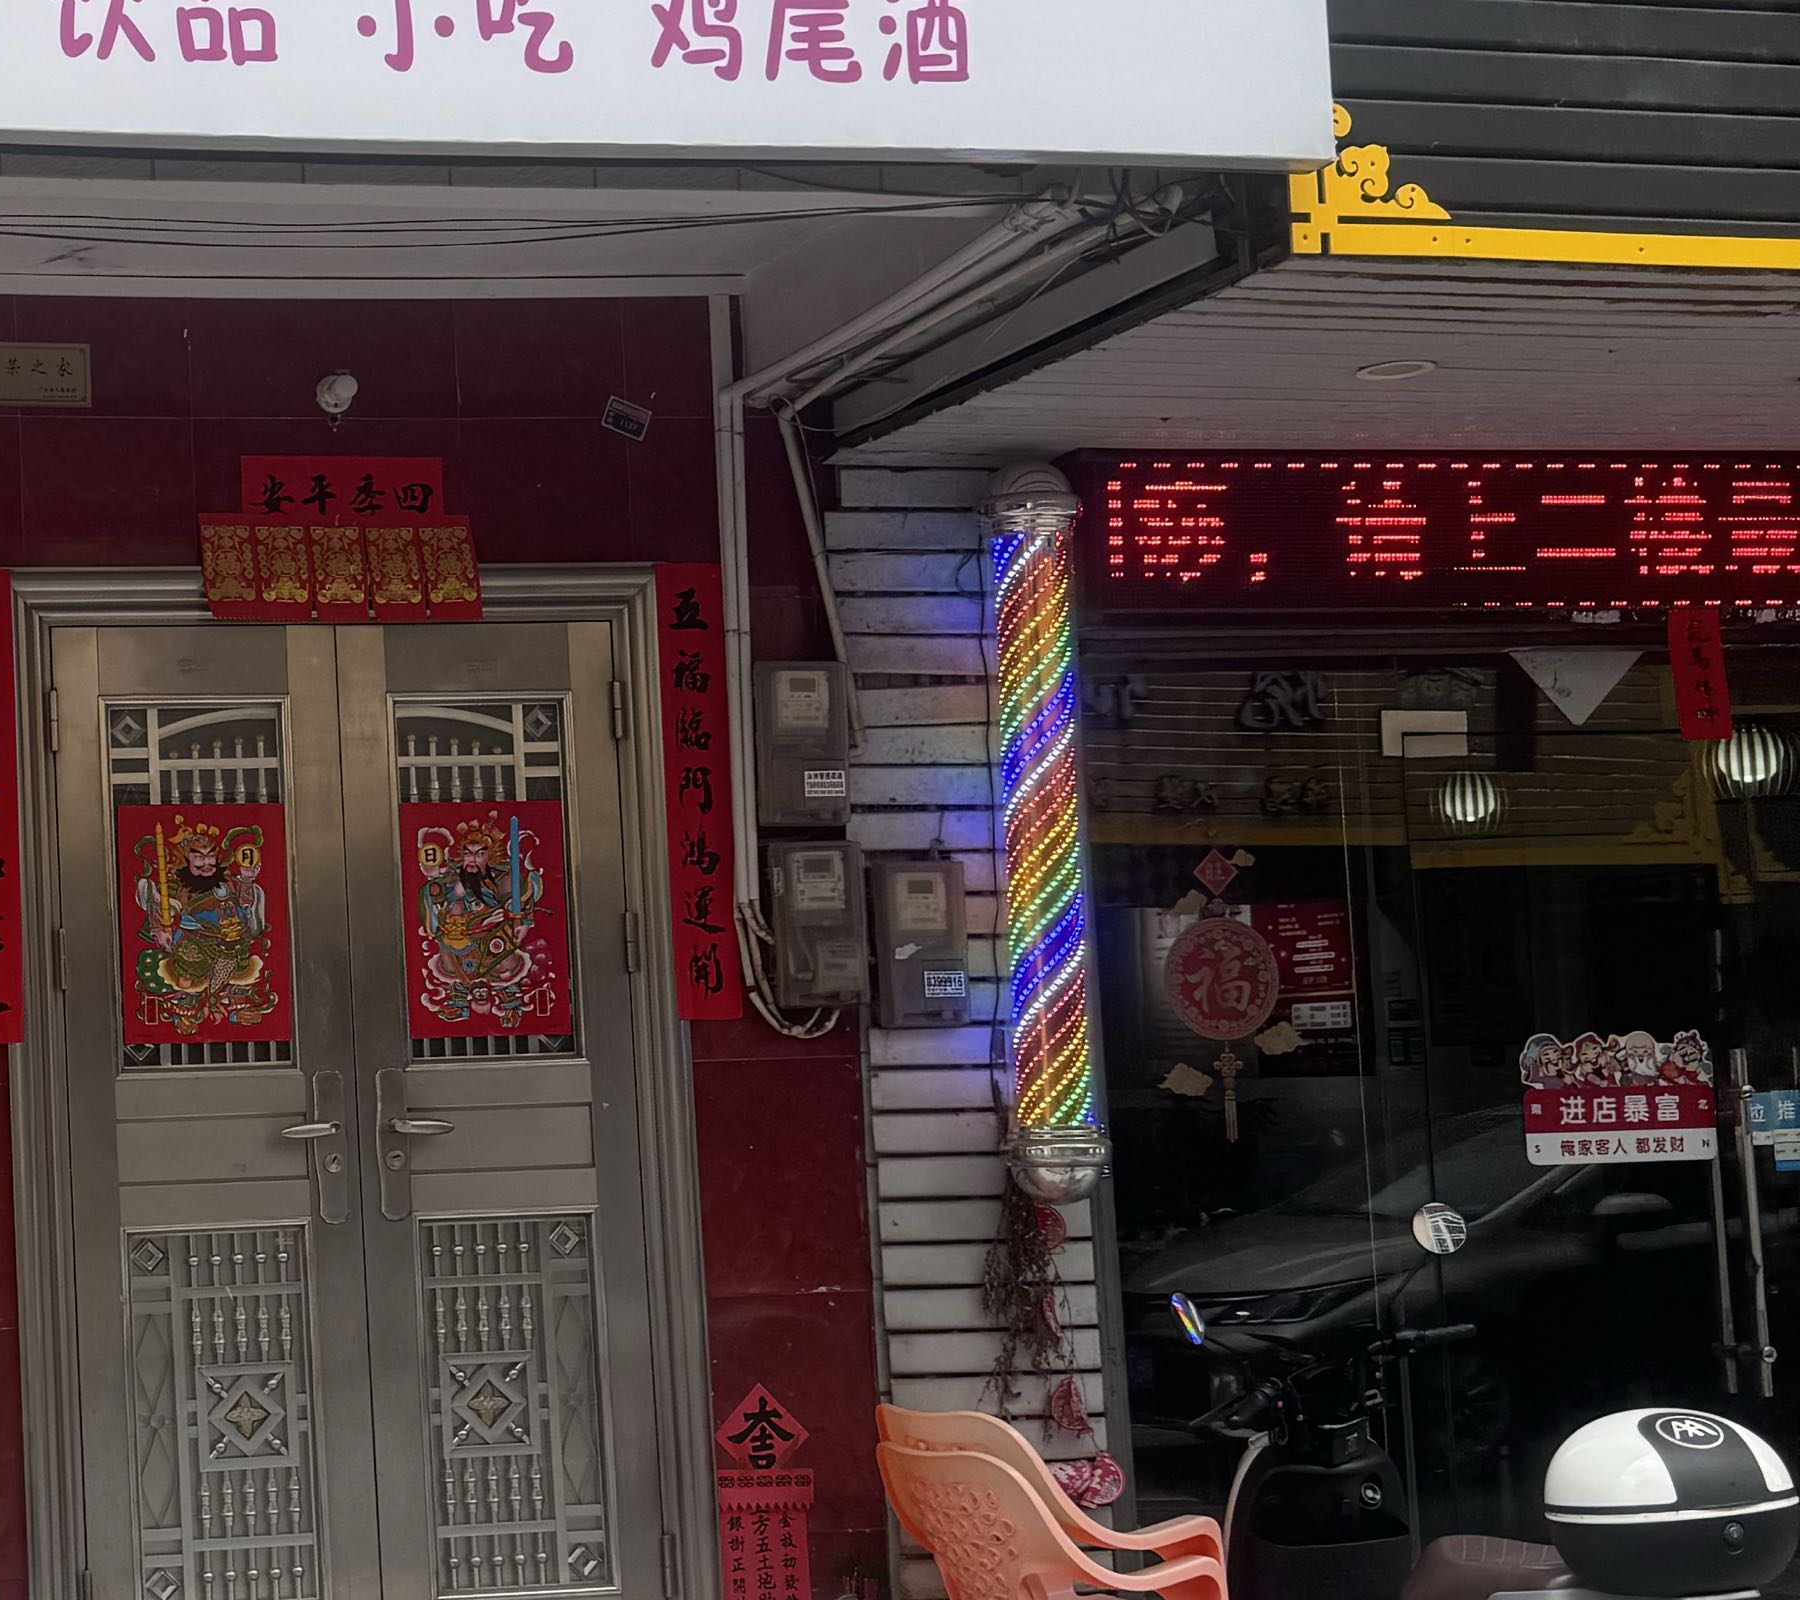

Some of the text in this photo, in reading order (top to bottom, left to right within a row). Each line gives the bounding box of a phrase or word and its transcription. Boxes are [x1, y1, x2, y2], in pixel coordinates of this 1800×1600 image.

[241, 848, 254, 867] 月
[424, 848, 438, 863] 日
[1185, 943, 1253, 1013] 福
[1560, 1093, 1680, 1125] 进店暴富
[1635, 1136, 1685, 1154] 都发财
